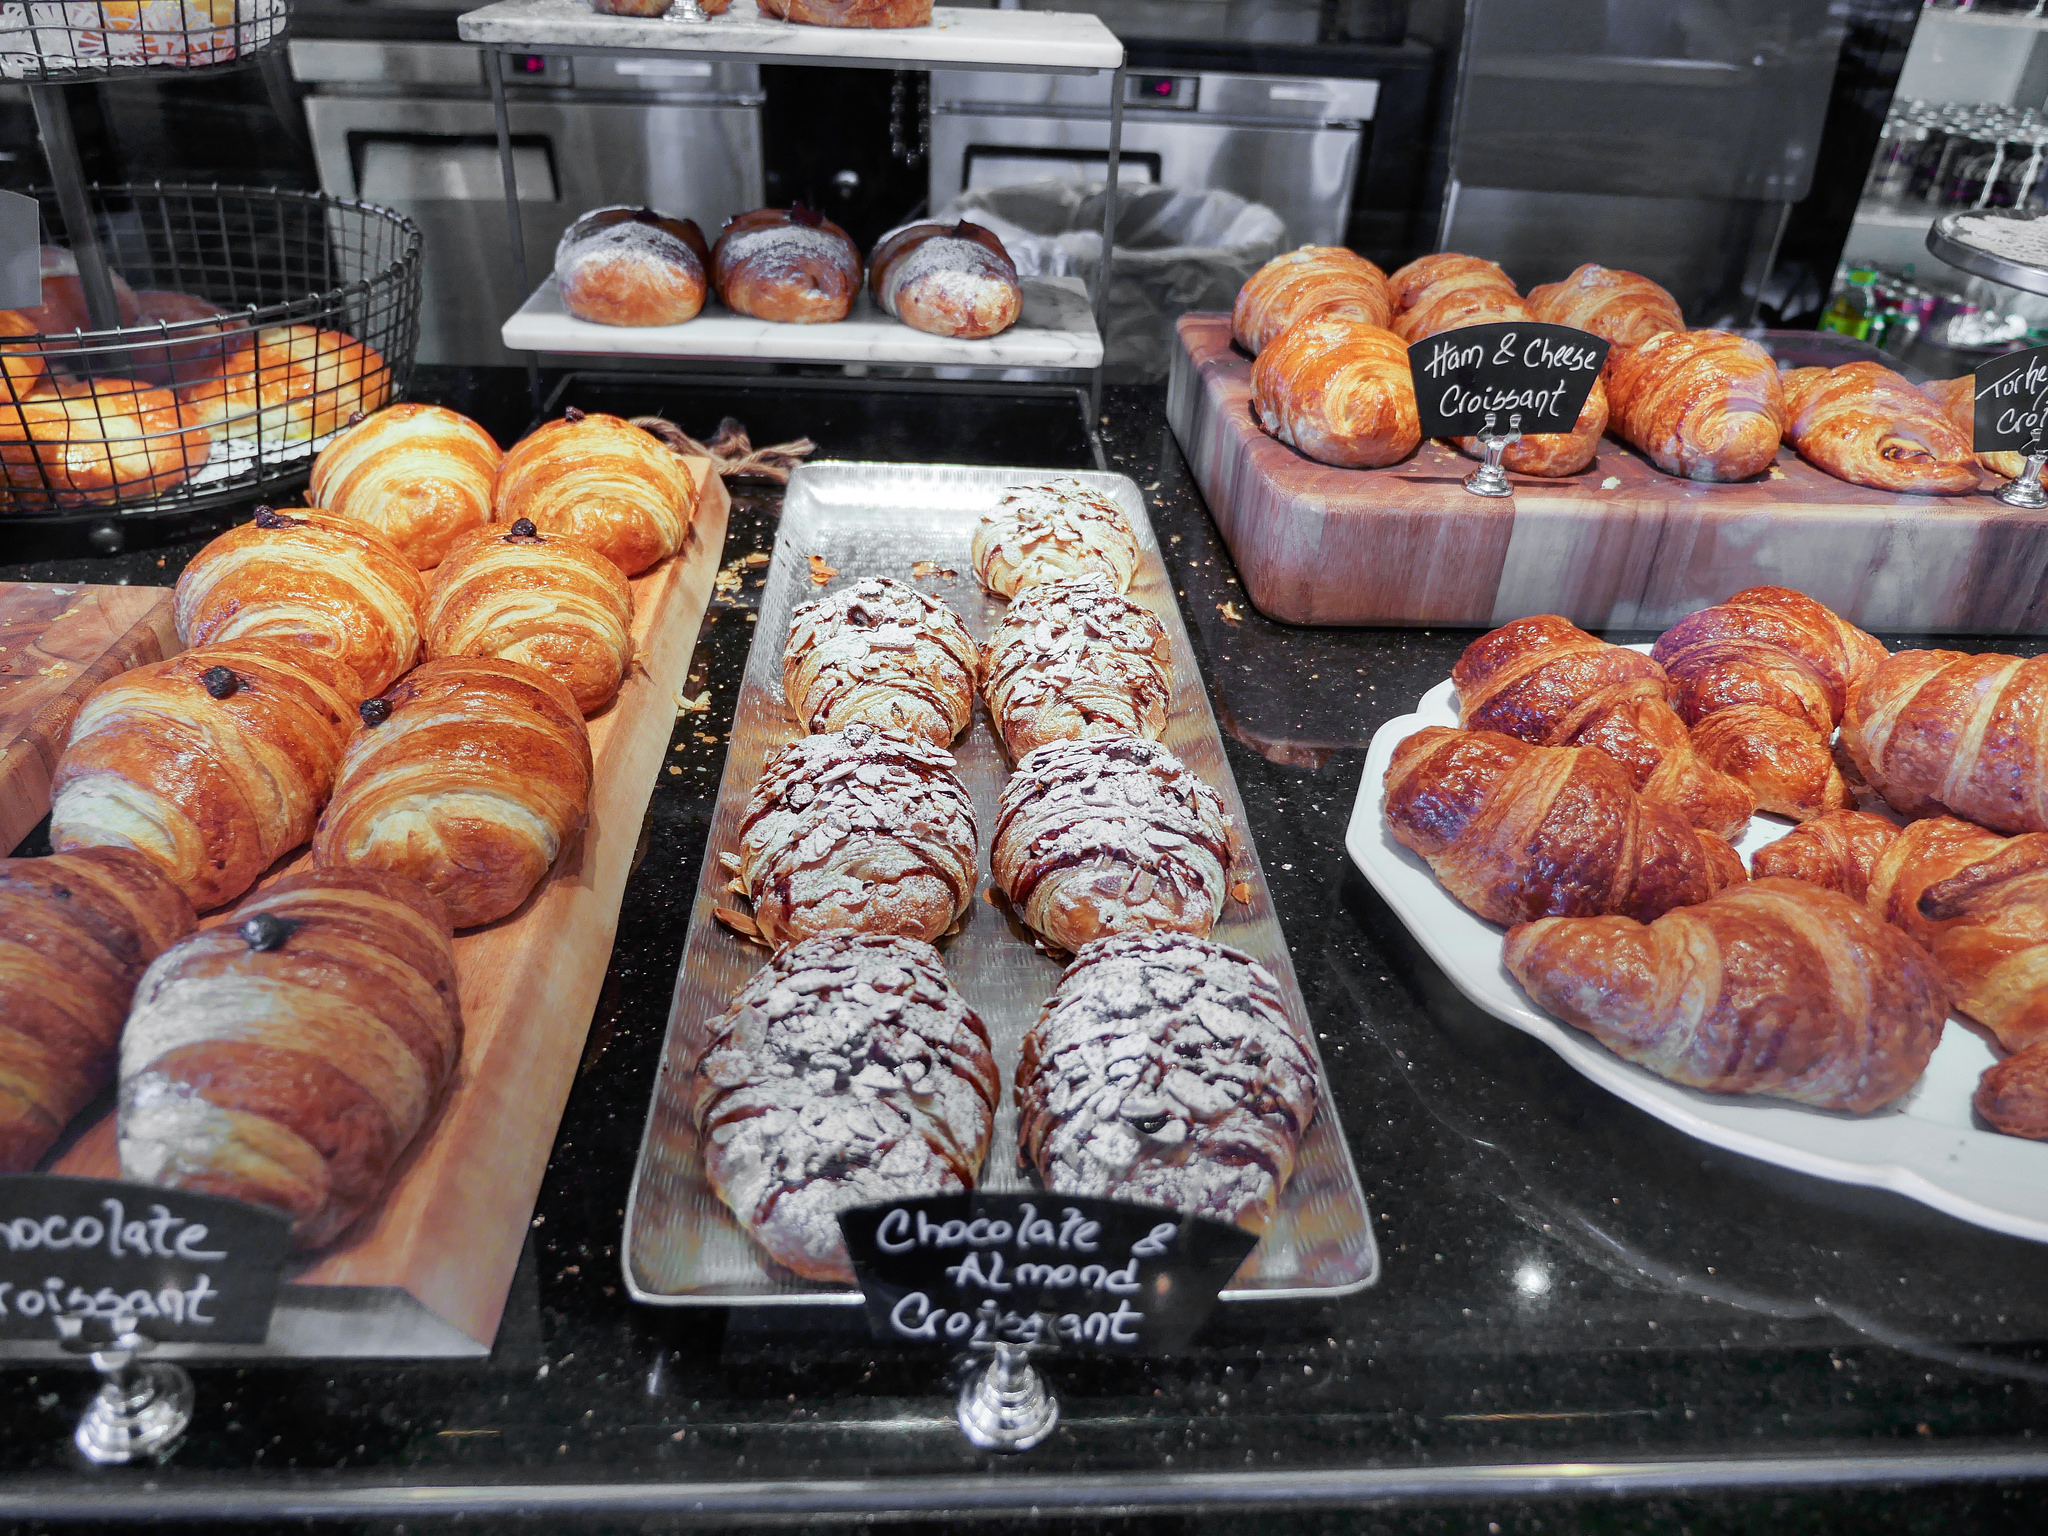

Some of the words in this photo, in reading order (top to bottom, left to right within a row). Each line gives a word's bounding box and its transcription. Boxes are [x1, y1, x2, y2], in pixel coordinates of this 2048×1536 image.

[1424, 341, 1484, 379] Ham
[1492, 332, 1517, 366] &
[1523, 338, 1597, 371] Cheese
[1439, 379, 1567, 418] Croissant
[876, 1202, 1101, 1254] Chocolate
[1132, 1222, 1178, 1257] &
[890, 1291, 1145, 1345] Croissant
